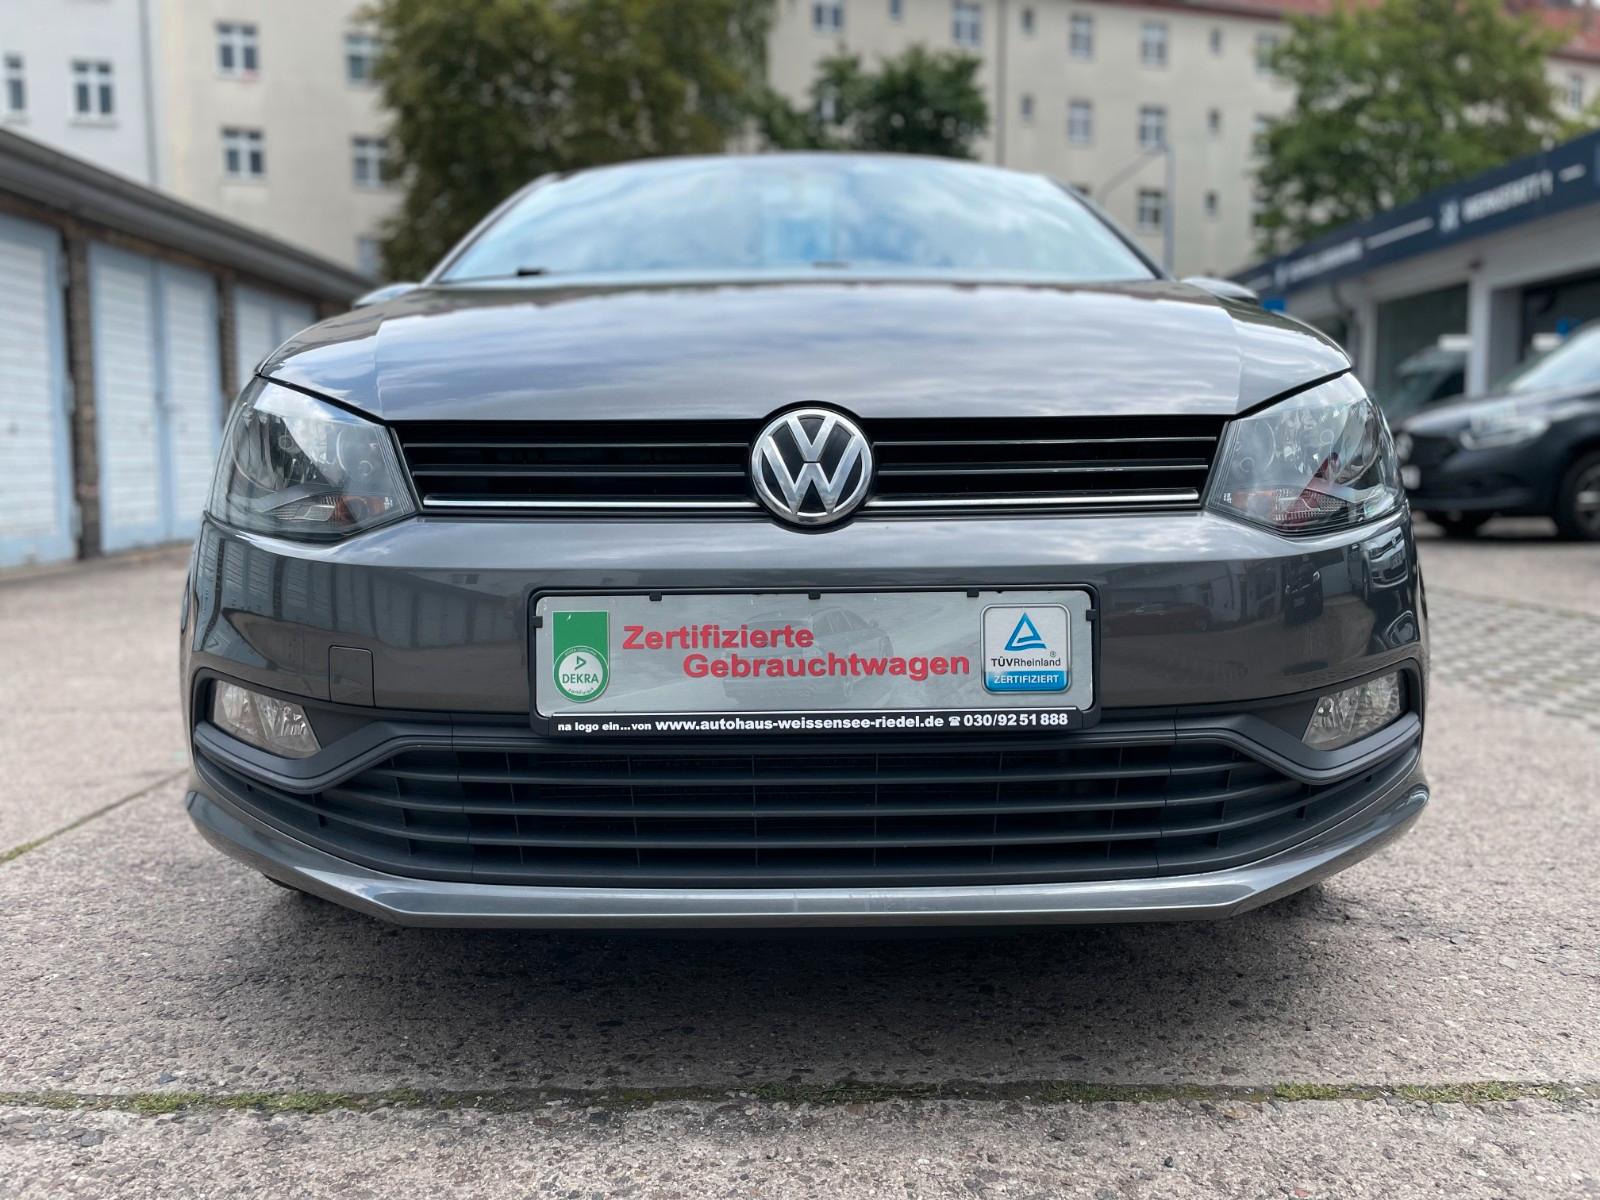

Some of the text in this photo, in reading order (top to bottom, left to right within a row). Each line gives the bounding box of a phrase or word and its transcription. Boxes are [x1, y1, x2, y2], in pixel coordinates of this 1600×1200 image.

[622, 625, 814, 649] Zertifizierte
[683, 653, 970, 681] Gebrauchtwagen
[562, 673, 599, 684] DEKRA
[993, 674, 1060, 684] ZERTIFIZIERT
[557, 722, 572, 732] na
[574, 721, 600, 733] logo
[655, 715, 945, 731] www.autohaus-weissensee-riedel.de
